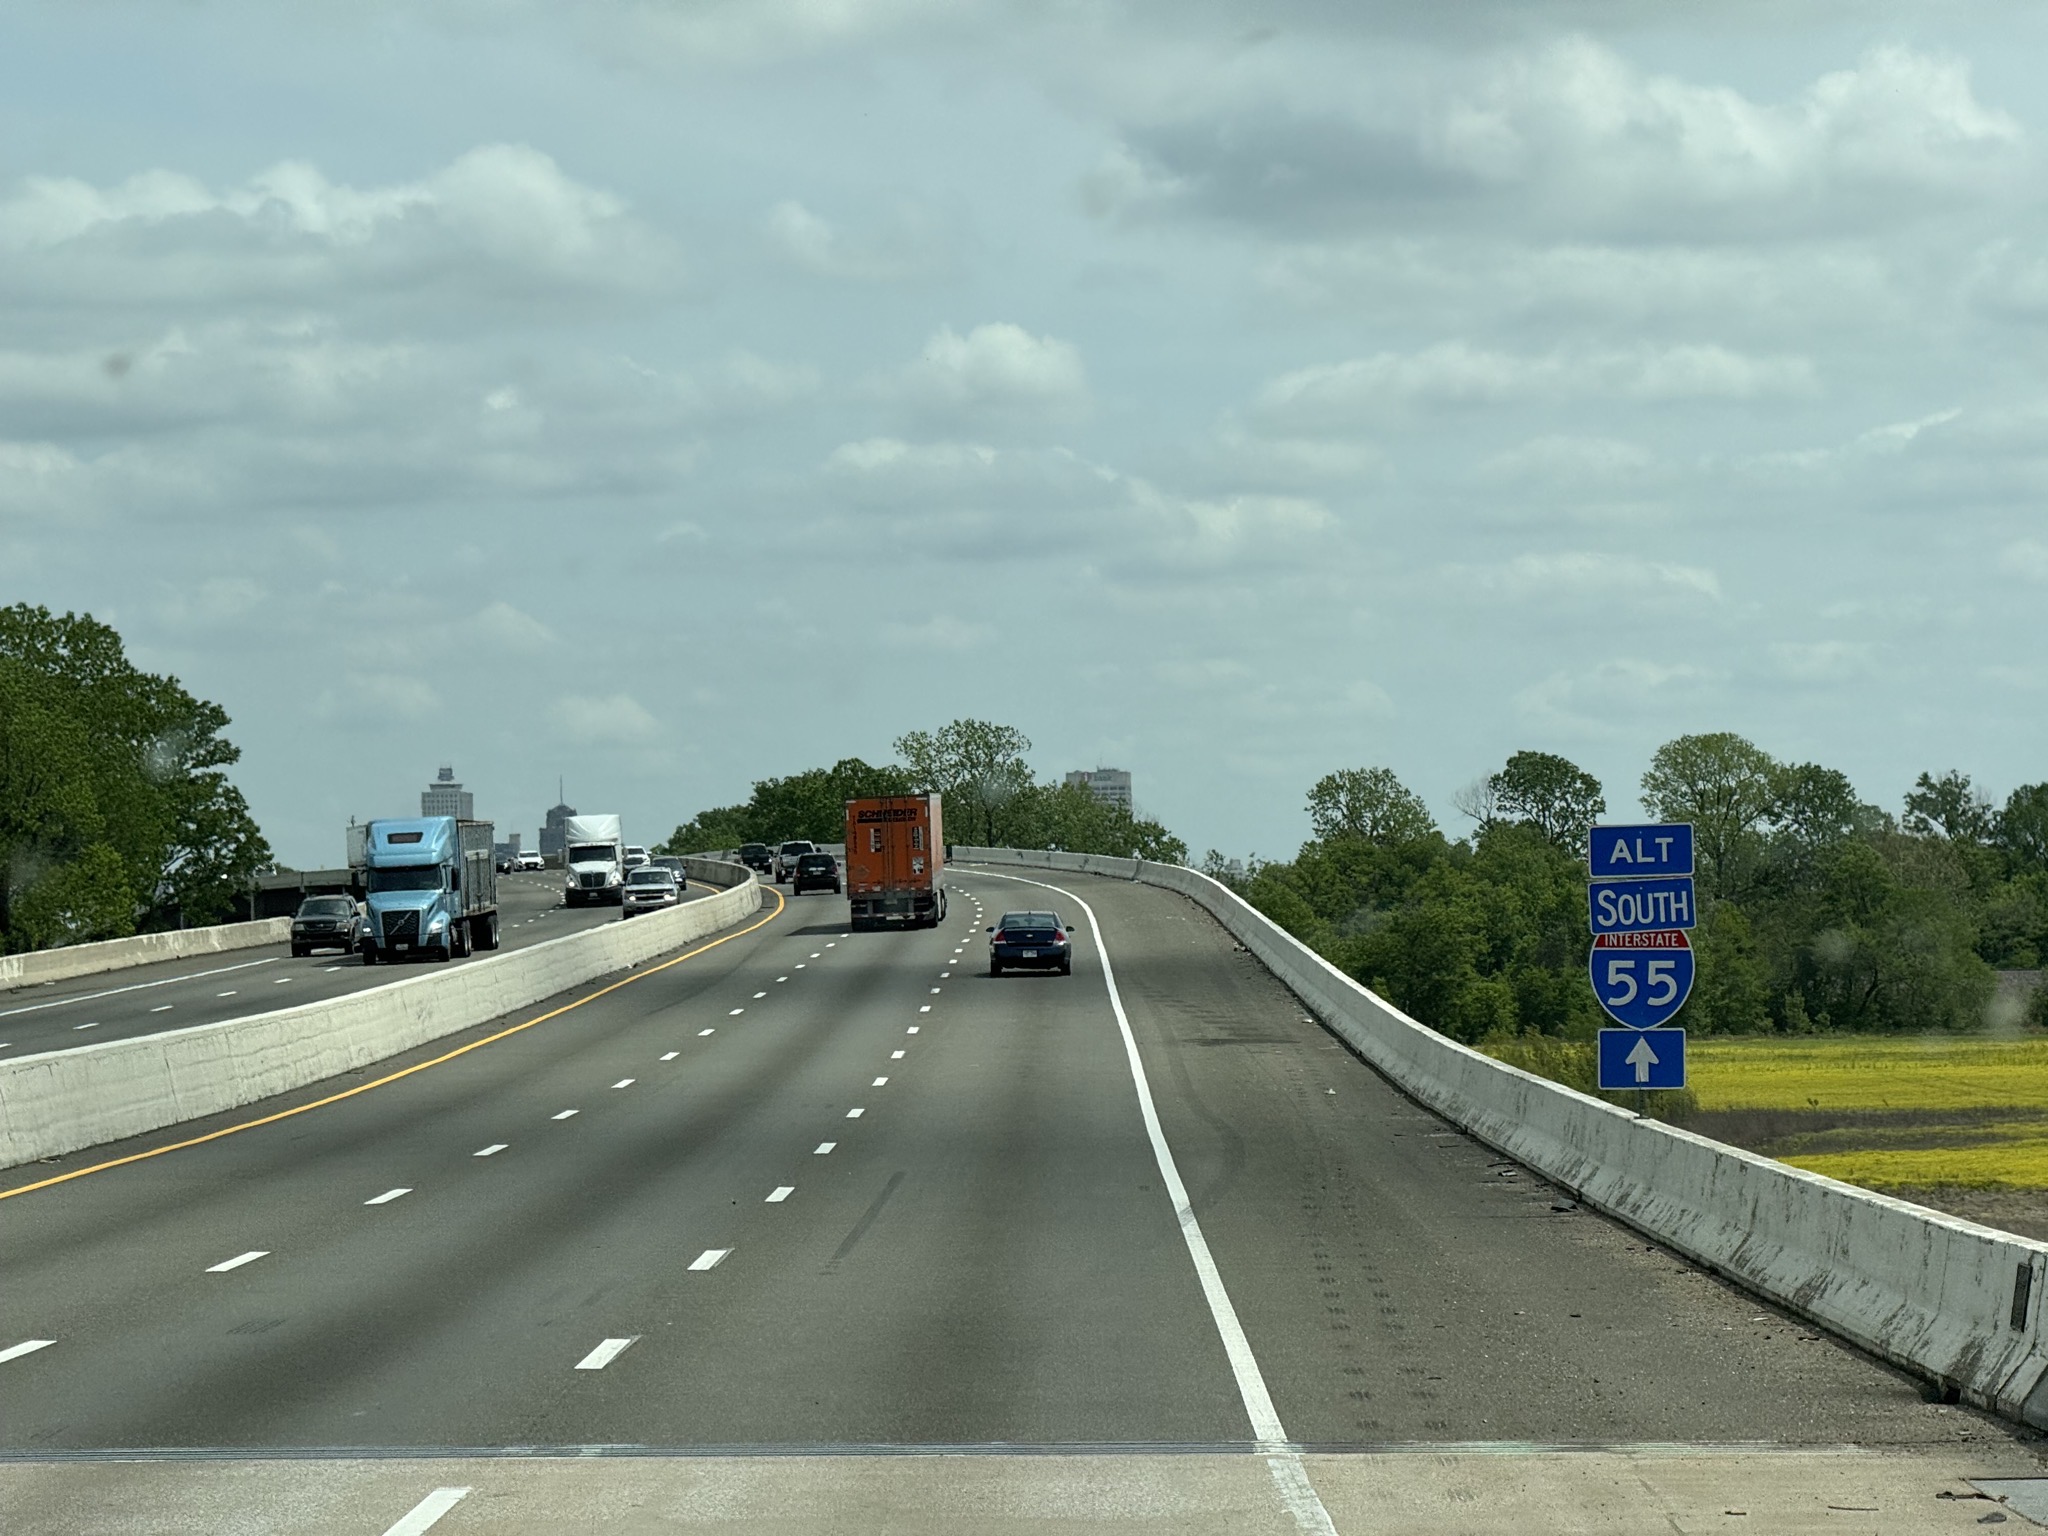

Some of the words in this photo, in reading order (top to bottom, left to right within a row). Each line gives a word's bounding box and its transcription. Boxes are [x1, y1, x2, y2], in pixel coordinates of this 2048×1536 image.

[1609, 837, 1674, 864] ALT
[1597, 889, 1689, 927] SOUTH
[1604, 932, 1679, 948] INTERSTATE
[1607, 960, 1678, 1006] 55
